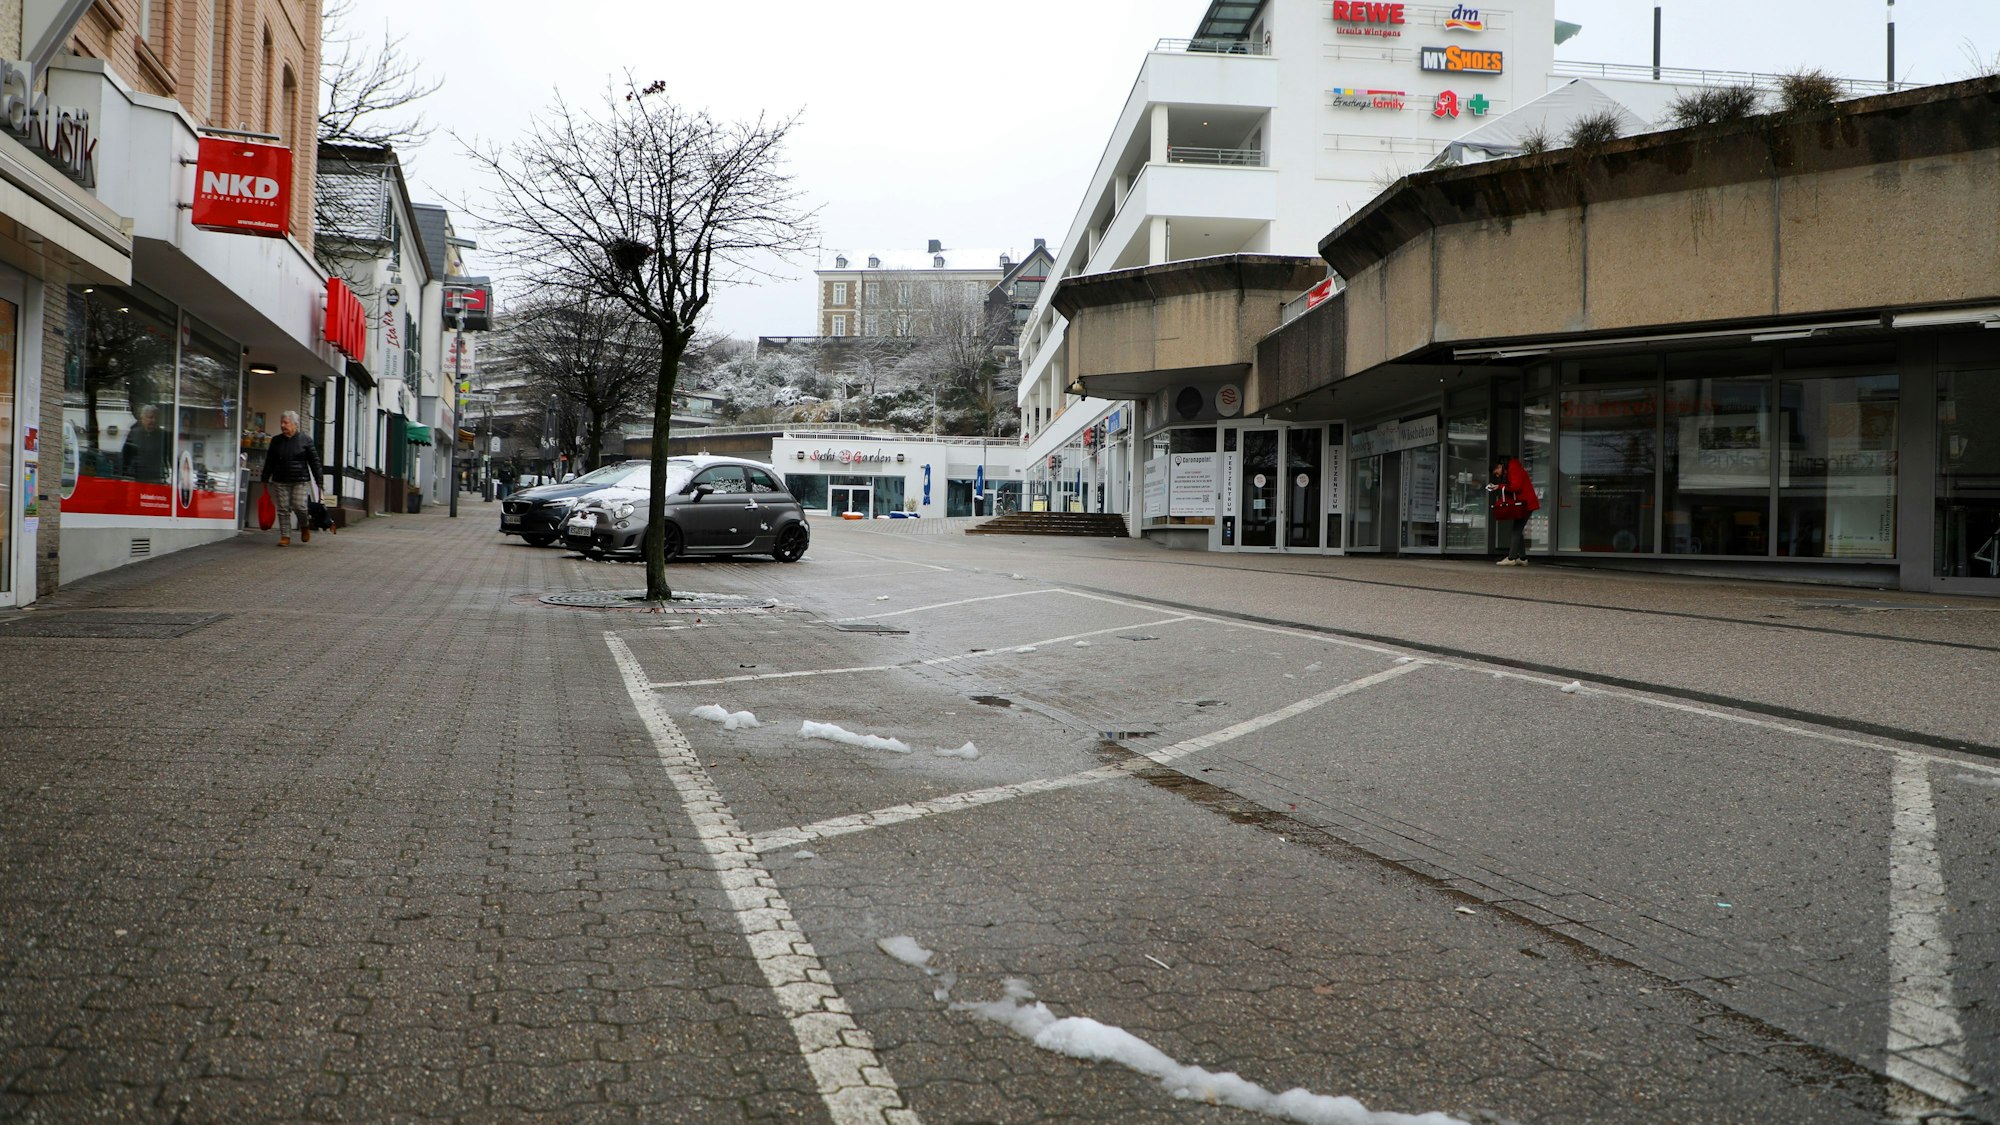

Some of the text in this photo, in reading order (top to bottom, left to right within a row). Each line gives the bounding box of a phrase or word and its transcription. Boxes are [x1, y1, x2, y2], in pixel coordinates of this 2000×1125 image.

[1333, 0, 1405, 24] REWE
[1451, 4, 1479, 21] dm
[1336, 27, 1401, 38] Ursula Wintgens
[1372, 97, 1405, 111] family
[202, 170, 279, 200] NKD
[337, 277, 366, 363] NKD
[383, 310, 400, 349] Italia
[809, 448, 892, 464] Sushi Garden
